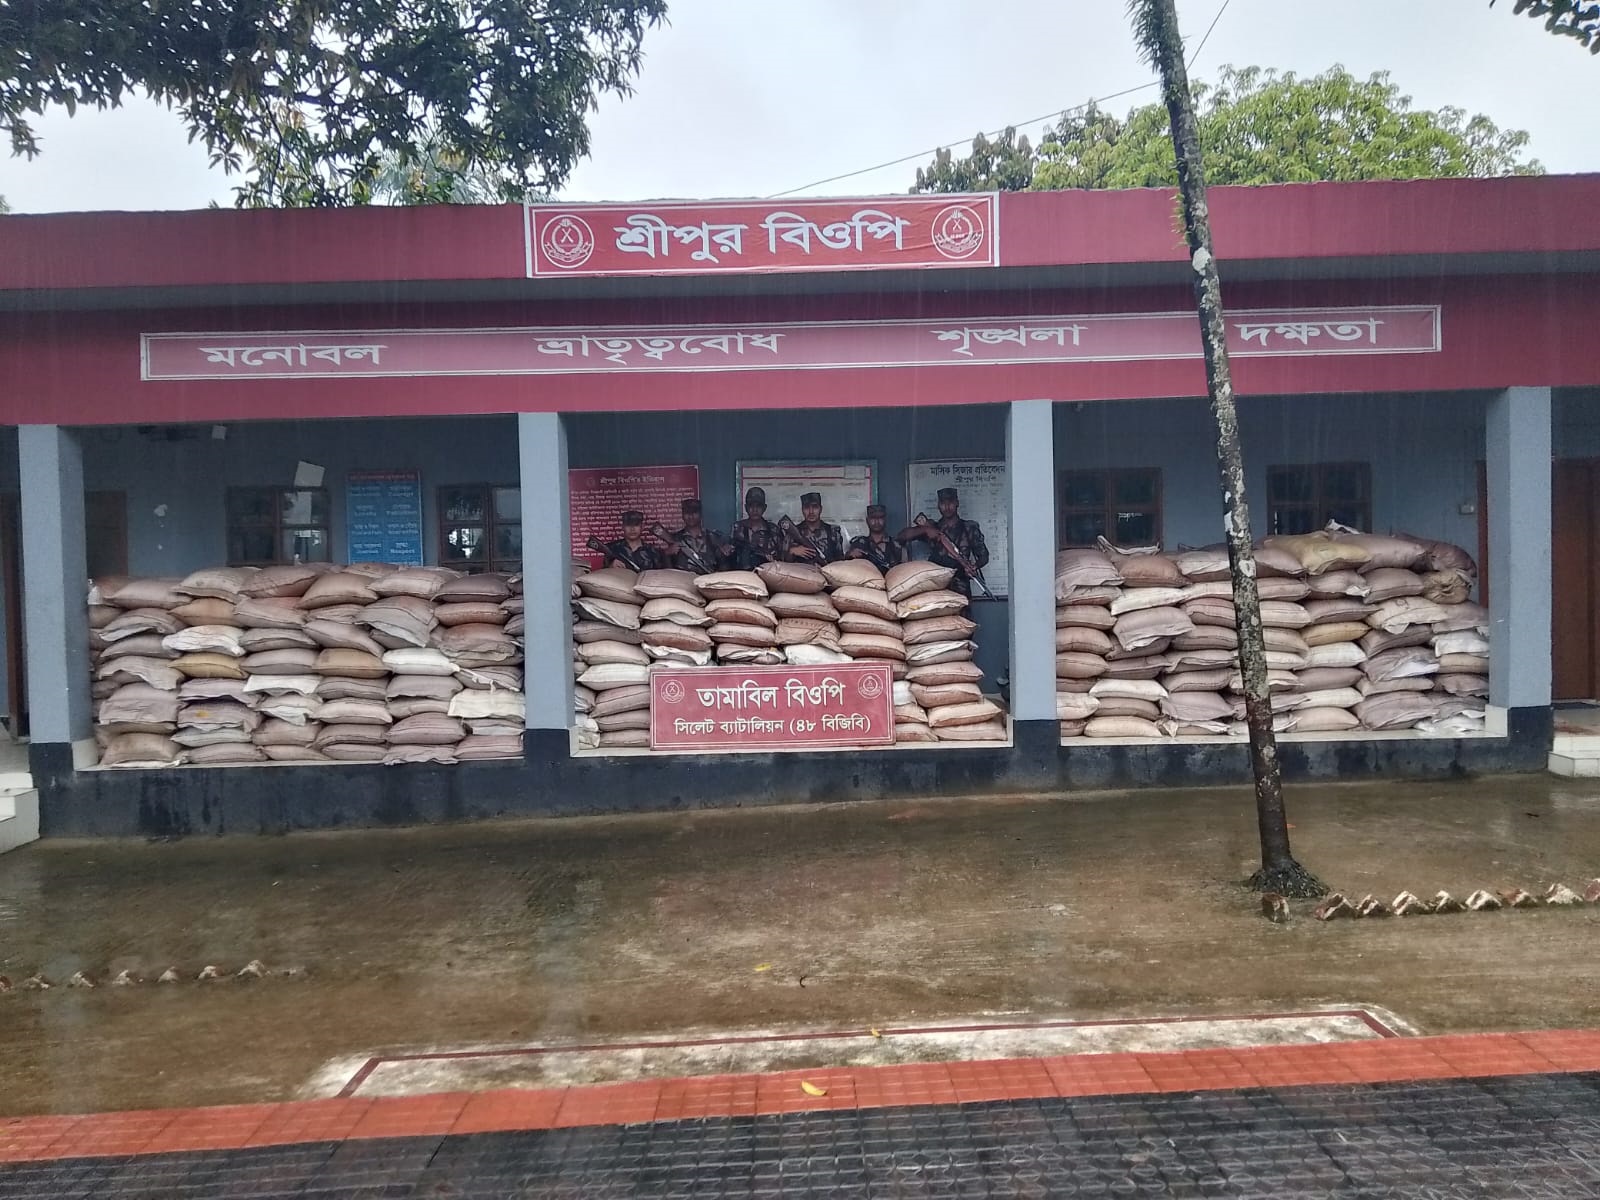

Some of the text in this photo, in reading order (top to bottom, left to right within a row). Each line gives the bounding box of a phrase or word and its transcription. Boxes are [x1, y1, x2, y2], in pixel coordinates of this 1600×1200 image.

[614, 209, 912, 264] শ্রীপুর বিওপি
[198, 317, 1385, 368] মনোবল ভ্রাতৃত্ববোধ শৃঙ্খলা দক্ষতা
[695, 676, 846, 710] তামাবিল বিওপি
[673, 713, 872, 736] সিলেট ব্যাটালিয়ন (৪৮ বিজিবি)
